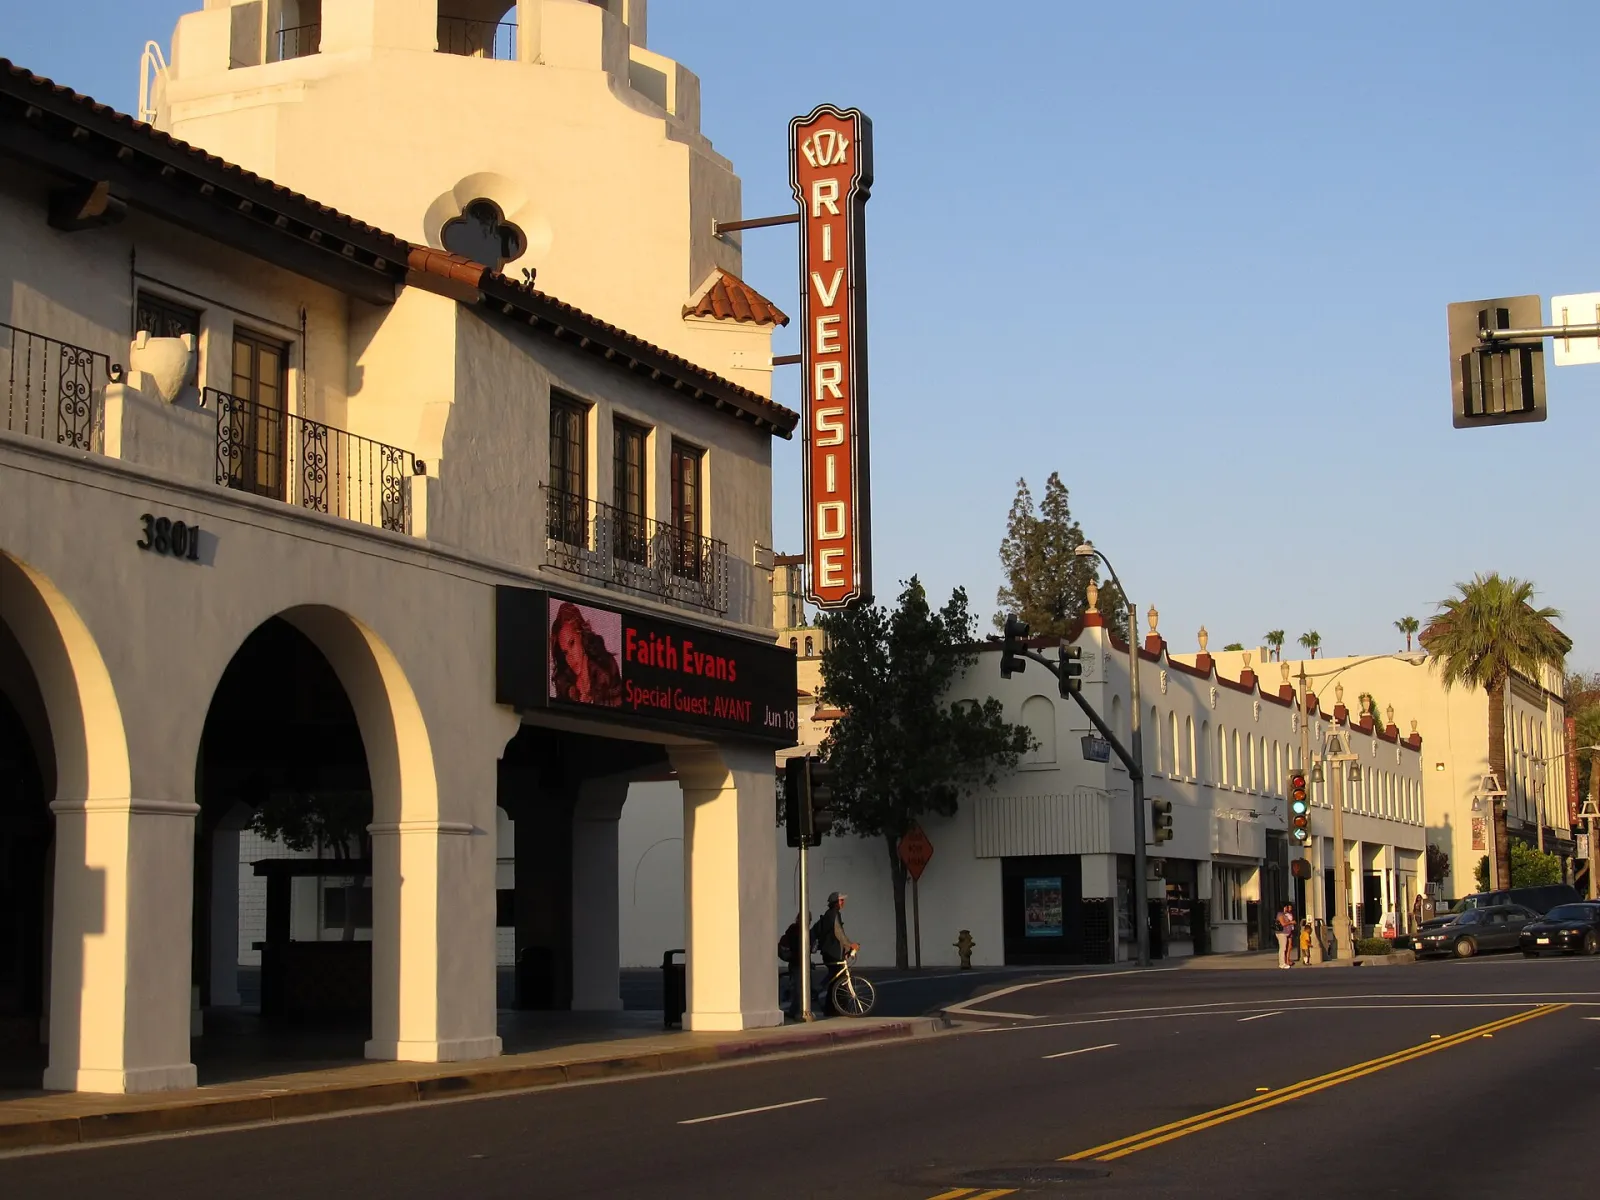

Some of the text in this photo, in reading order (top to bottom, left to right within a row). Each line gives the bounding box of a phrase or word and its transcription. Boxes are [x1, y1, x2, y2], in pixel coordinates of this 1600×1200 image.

[801, 129, 850, 168] FOX
[810, 178, 846, 588] RIVERSIDE
[137, 513, 199, 561] 3801
[625, 627, 737, 682] Faith Evans
[626, 679, 671, 710] Special
[713, 695, 752, 722] AVANT
[763, 705, 796, 730] Jun 18
